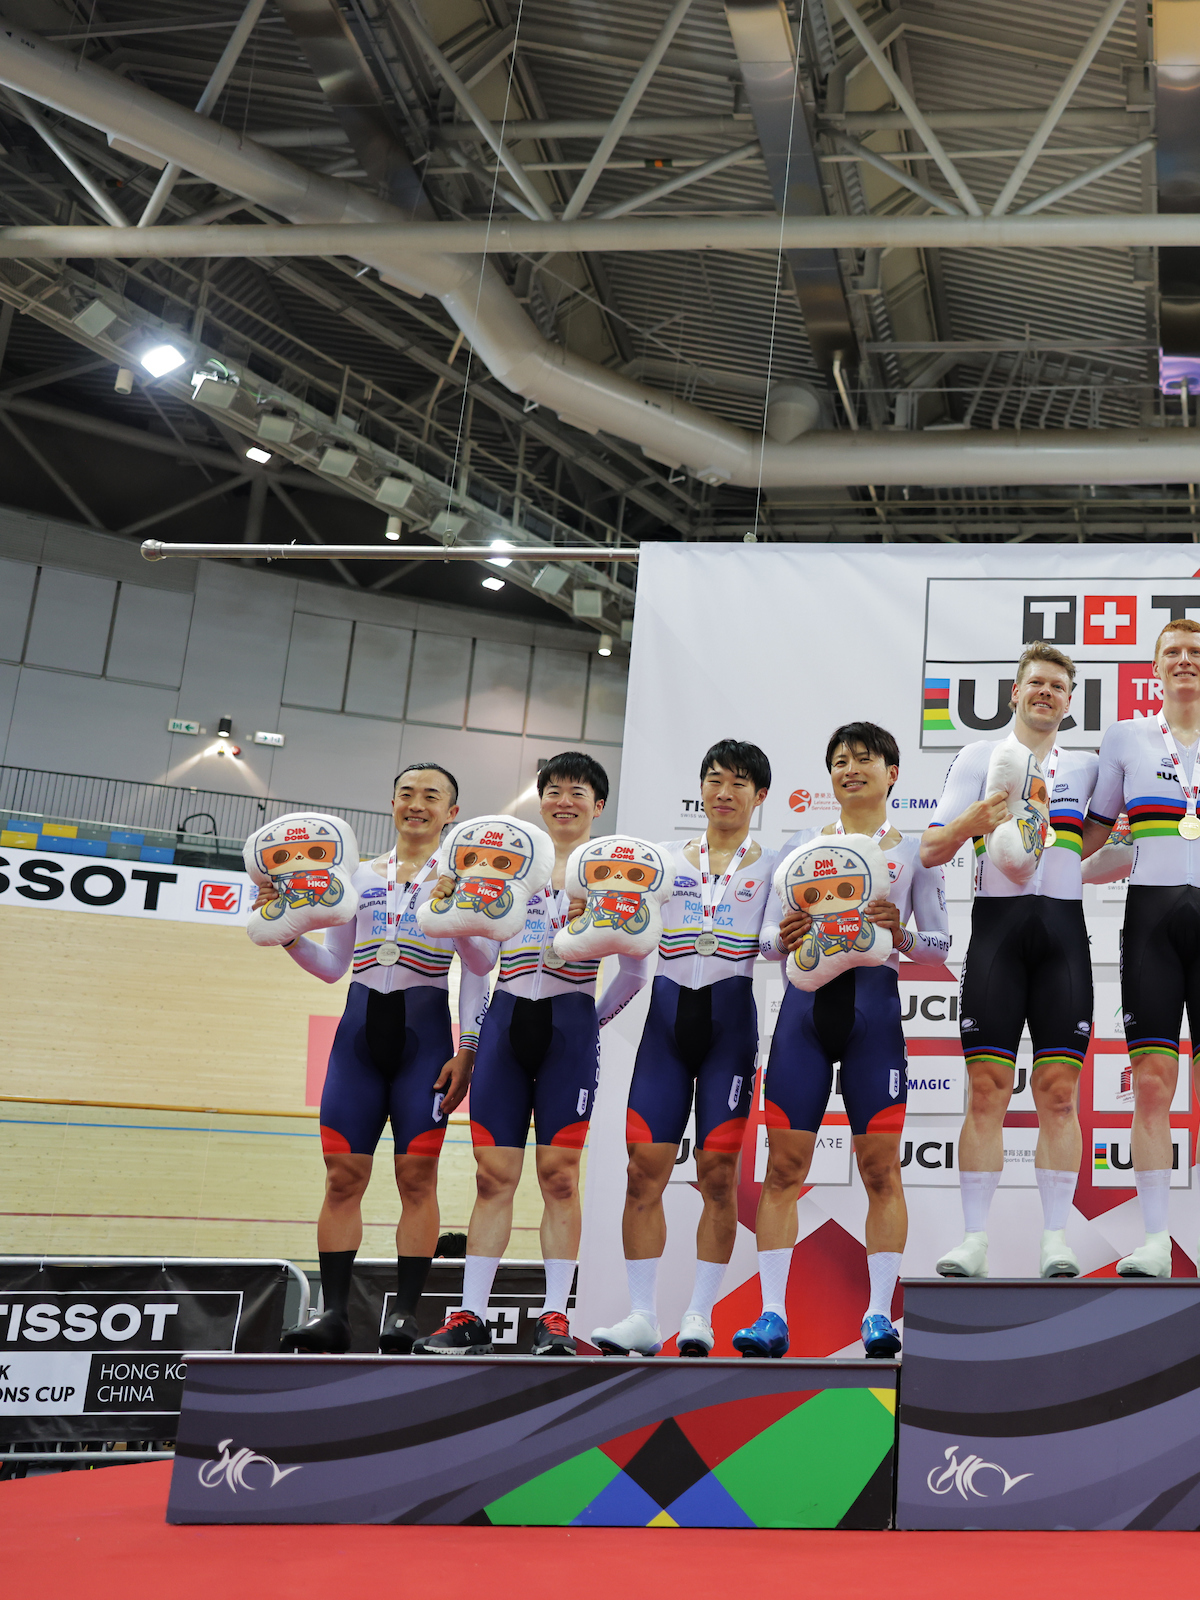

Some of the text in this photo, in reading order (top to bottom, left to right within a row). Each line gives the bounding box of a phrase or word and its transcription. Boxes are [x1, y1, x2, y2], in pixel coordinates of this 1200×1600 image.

[957, 678, 1102, 731] UI
[1162, 772, 1180, 783] UC
[891, 798, 938, 809] GERMA
[286, 827, 306, 836] DIN
[484, 830, 504, 841] DIN
[614, 846, 634, 855] DIN
[814, 859, 834, 870] DIN
[0, 855, 178, 911] SOT
[307, 879, 328, 889] HKG
[477, 887, 499, 899] HKG
[672, 890, 702, 899] UBARU
[527, 908, 545, 916] ARU
[616, 902, 636, 914] HKG
[684, 900, 731, 914] Raken
[839, 923, 860, 933] HKG
[907, 1079, 951, 1090] MAGIC
[1110, 1143, 1179, 1169] UI
[0, 1302, 179, 1342] ISSOT
[100, 1363, 187, 1381] HONG KO
[35, 1386, 75, 1403] CUP
[97, 1385, 155, 1403] CHINA
